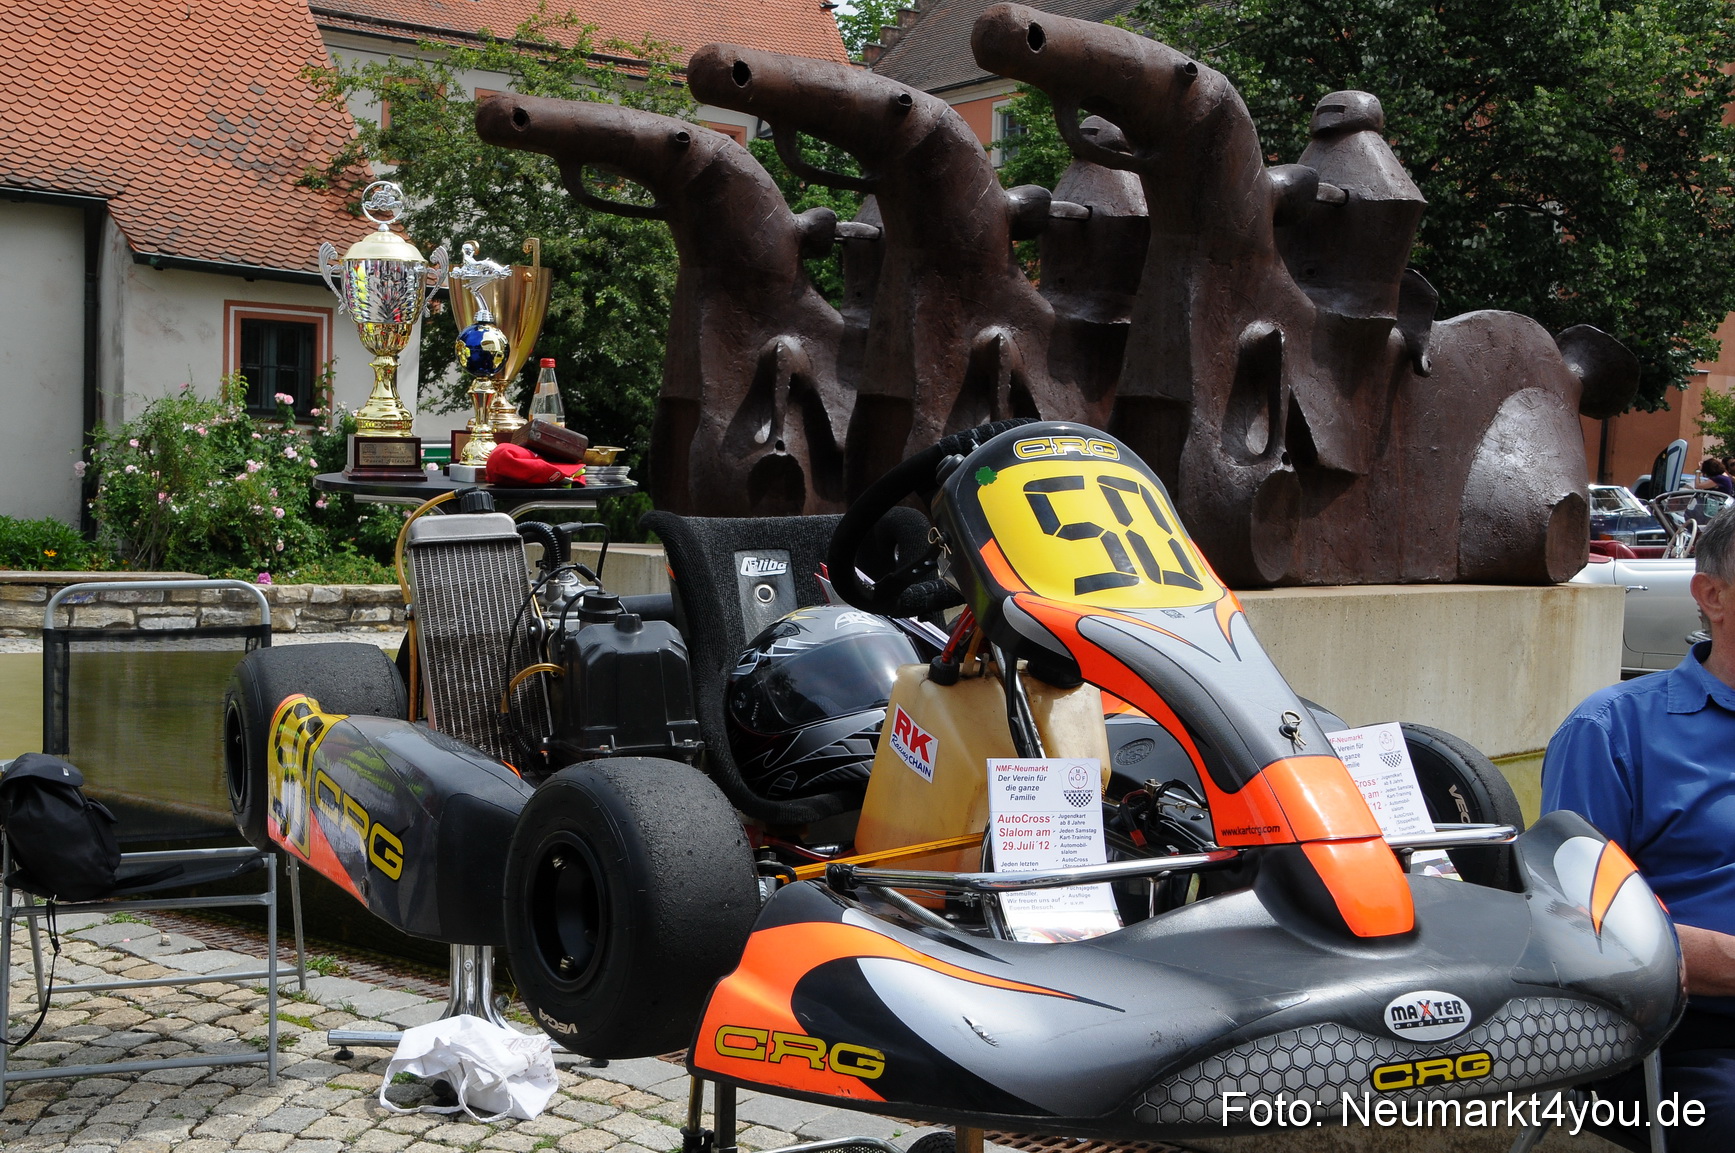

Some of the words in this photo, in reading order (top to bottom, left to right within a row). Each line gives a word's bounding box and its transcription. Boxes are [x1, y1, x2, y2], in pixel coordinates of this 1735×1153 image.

[1013, 436, 1121, 461] CRG
[1023, 475, 1204, 596] 50
[895, 708, 933, 764] RK
[891, 733, 909, 761] Racing
[908, 755, 932, 777] CHAIN
[1345, 753, 1361, 761] ganze
[1355, 778, 1377, 788] Cross
[1010, 793, 1036, 801] Familie
[1449, 784, 1471, 823] VEG
[997, 813, 1051, 824] AutoCross
[1221, 825, 1281, 836] www.kartcrg.com
[999, 827, 1033, 837] Slalom
[1036, 829, 1051, 837] am
[538, 1007, 578, 1035] VEGA
[1394, 1016, 1465, 1029] engines
[715, 1025, 886, 1079] CRG
[1373, 1052, 1491, 1091] CRG
